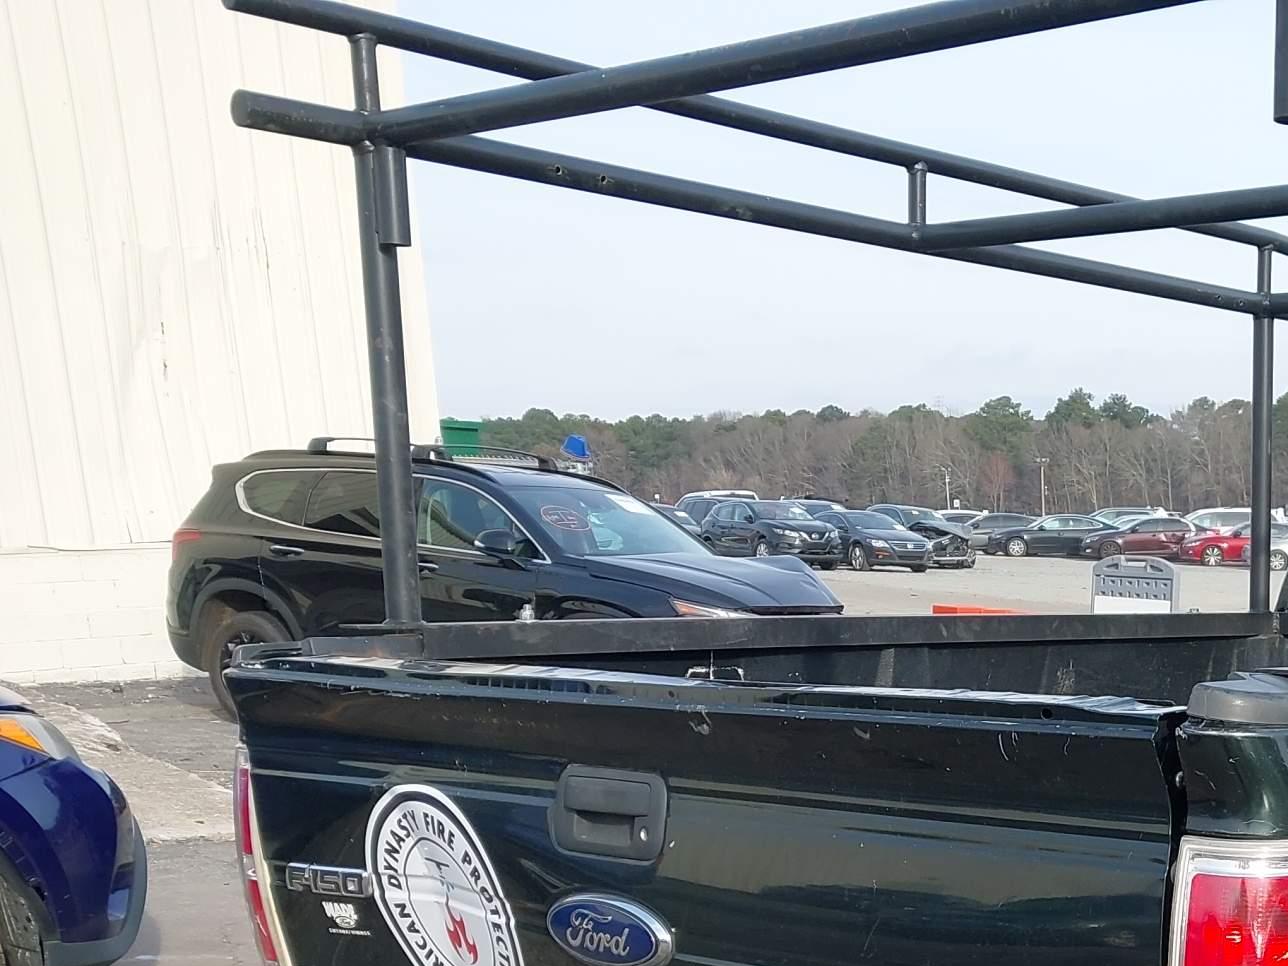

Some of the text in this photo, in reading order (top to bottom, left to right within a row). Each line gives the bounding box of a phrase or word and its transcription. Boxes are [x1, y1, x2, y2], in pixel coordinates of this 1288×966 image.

[383, 809, 420, 892] DYNASTY
[422, 811, 456, 853] FIRE
[286, 862, 373, 898] F-150
[565, 908, 631, 957] Ford
